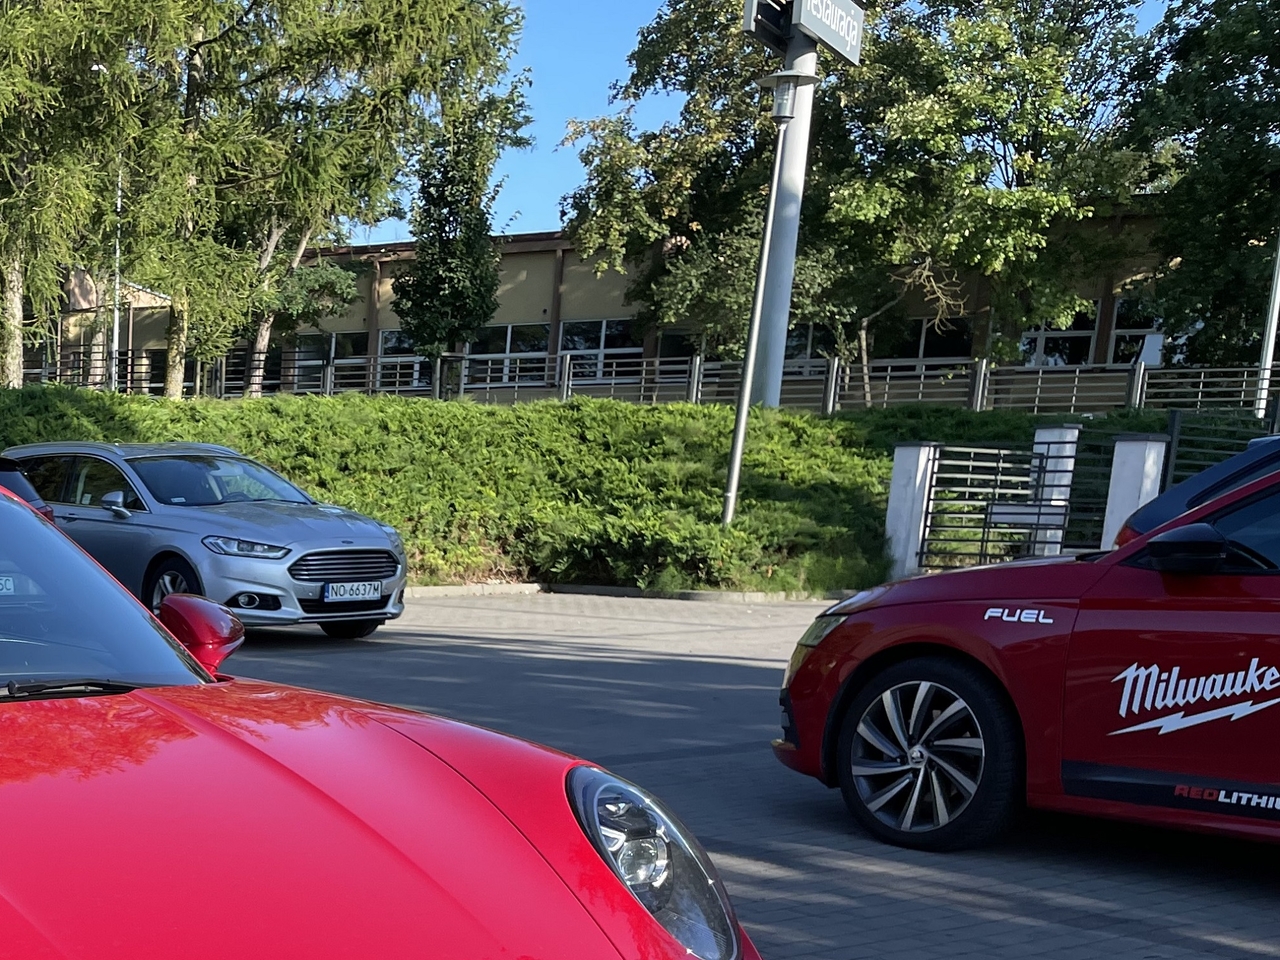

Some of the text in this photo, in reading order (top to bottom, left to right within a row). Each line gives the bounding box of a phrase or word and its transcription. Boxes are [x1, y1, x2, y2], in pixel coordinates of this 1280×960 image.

[331, 585, 346, 597] NO
[349, 583, 380, 596] 6637M
[984, 608, 1053, 624] FUEL
